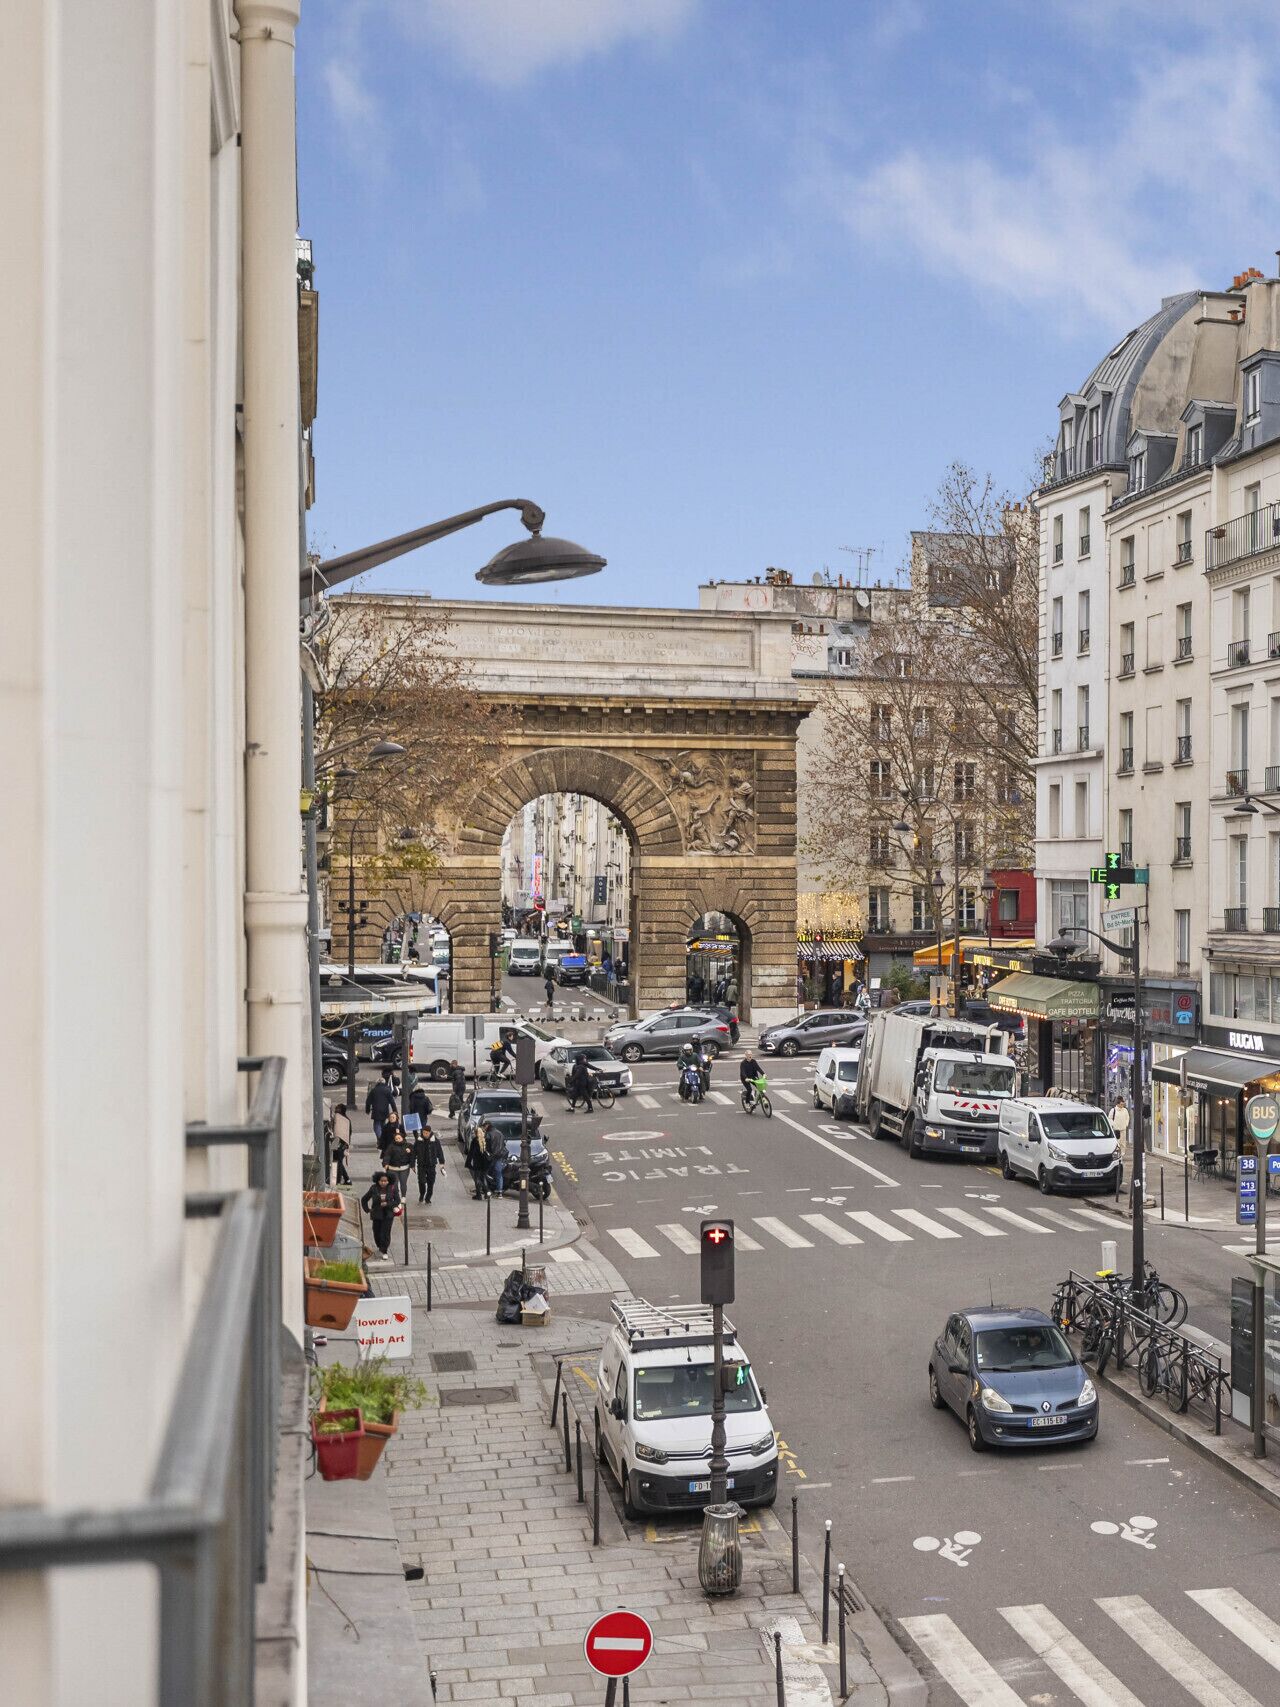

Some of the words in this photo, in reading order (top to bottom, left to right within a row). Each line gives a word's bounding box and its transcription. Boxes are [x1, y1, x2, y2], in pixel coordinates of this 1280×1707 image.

[1252, 1106, 1276, 1119] BUS
[1242, 1160, 1255, 1169] 38
[601, 1163, 750, 1182] TRAFIC
[358, 1318, 389, 1327] lower
[388, 1335, 404, 1343] Art
